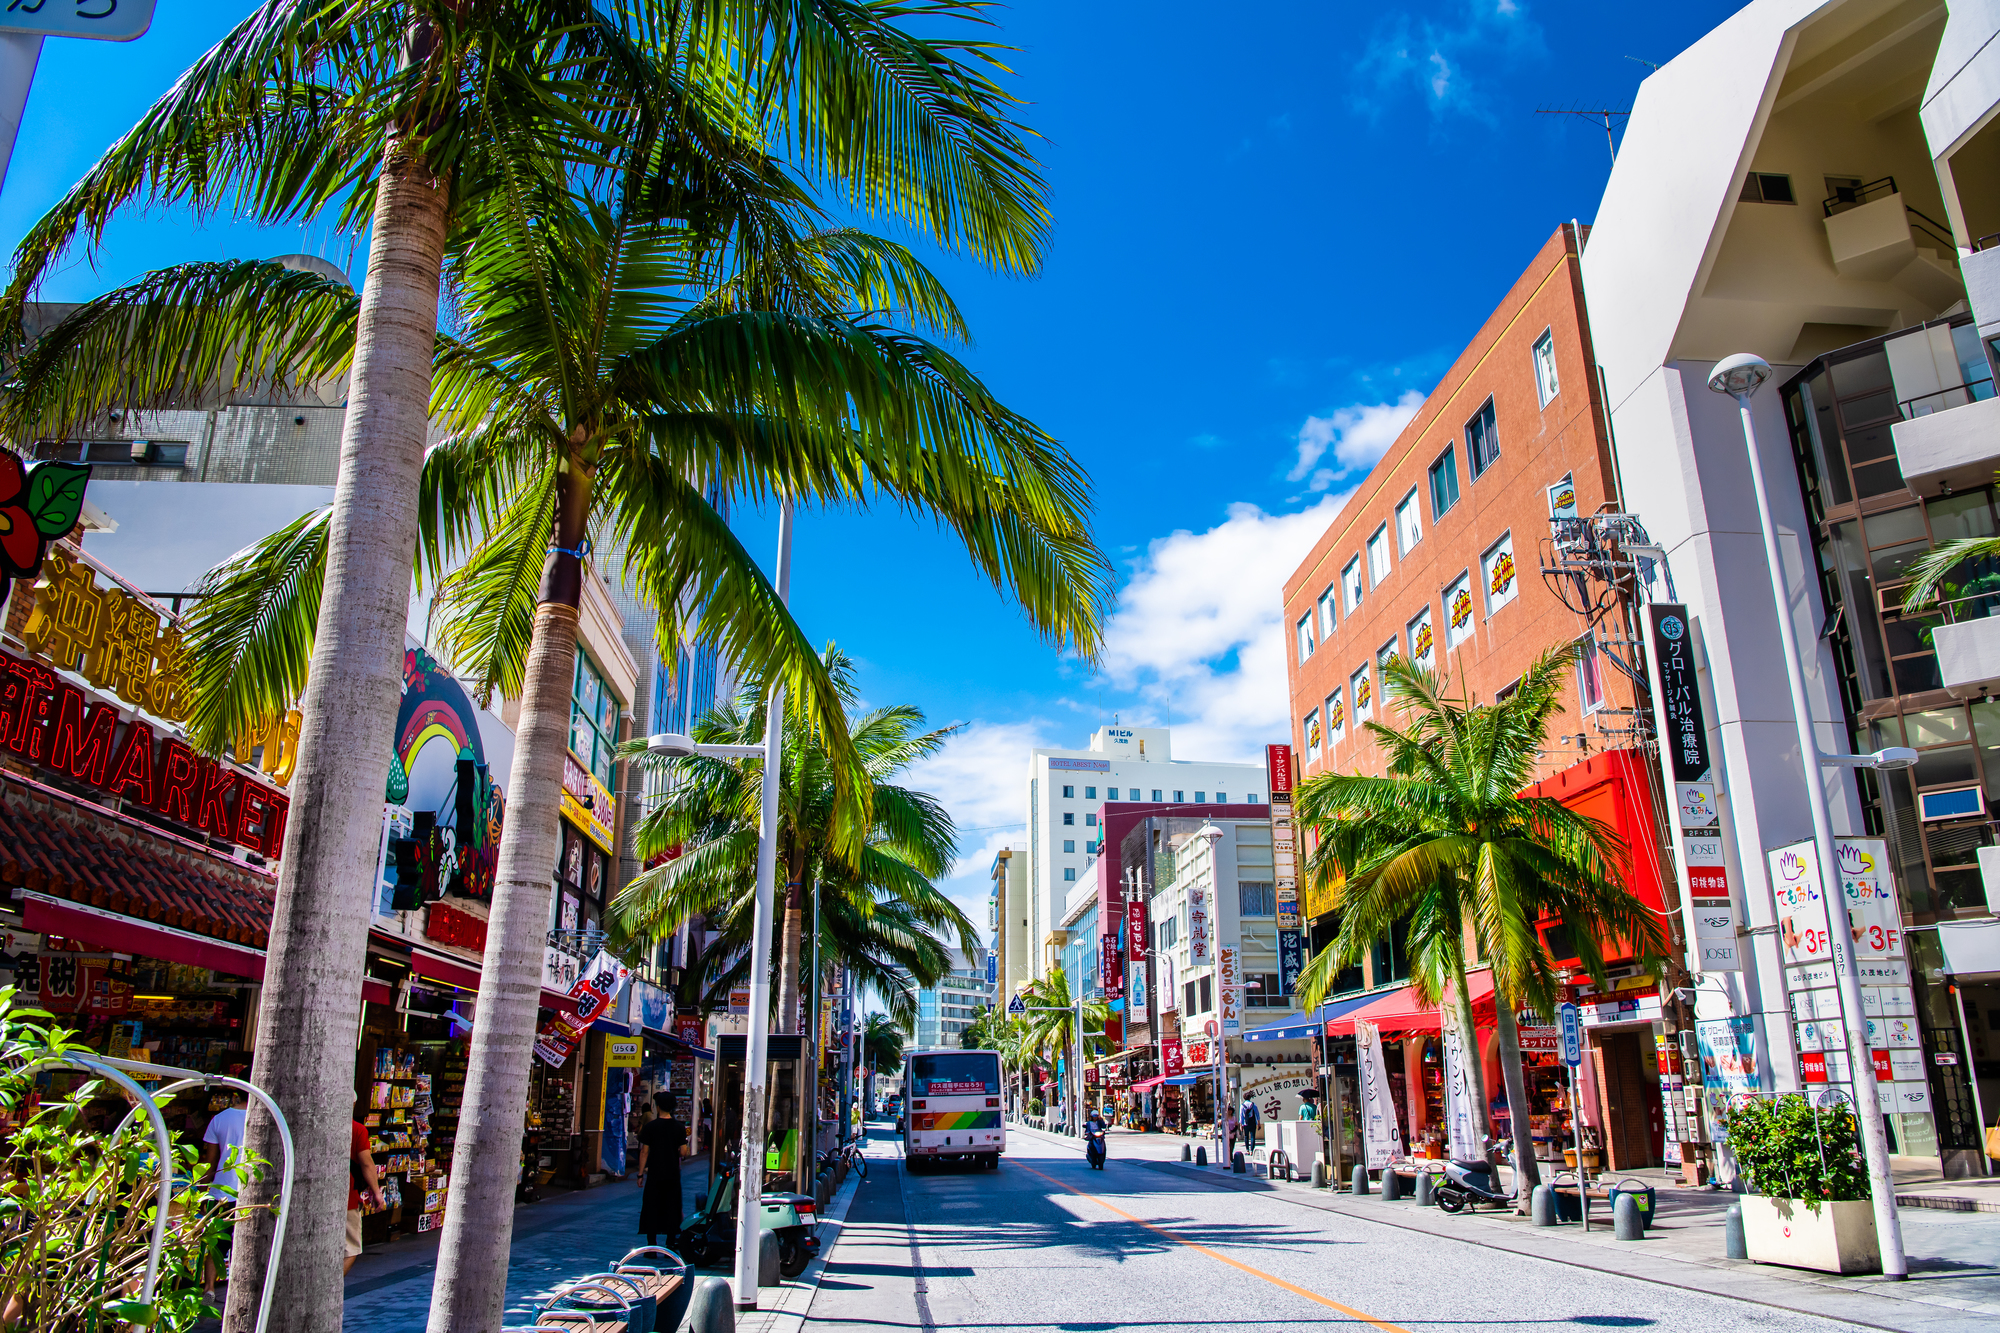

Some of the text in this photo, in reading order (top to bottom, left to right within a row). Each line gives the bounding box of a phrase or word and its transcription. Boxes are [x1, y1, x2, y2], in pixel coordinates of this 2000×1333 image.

[1493, 554, 1512, 579] DARTS
[1669, 642, 1700, 764] グローバル治療院
[1682, 806, 1713, 815] てもみん
[1690, 844, 1717, 856] JOSET
[1691, 877, 1725, 889] 月桃物語
[1776, 884, 1819, 907] てもみん
[1805, 928, 1828, 954] 3F
[1869, 925, 1899, 951] 3F
[1704, 948, 1733, 959] JOSET
[1835, 943, 1846, 974] 937
[1793, 972, 1829, 982] GS久茂地ビル
[1521, 1038, 1558, 1048] キッドハ
[1565, 1014, 1577, 1055] 国際通り
[1891, 1034, 1914, 1042] てもみん
[613, 1043, 636, 1052] りらくる
[1363, 1046, 1378, 1102] ラウンジ
[1263, 1096, 1281, 1120] 守
